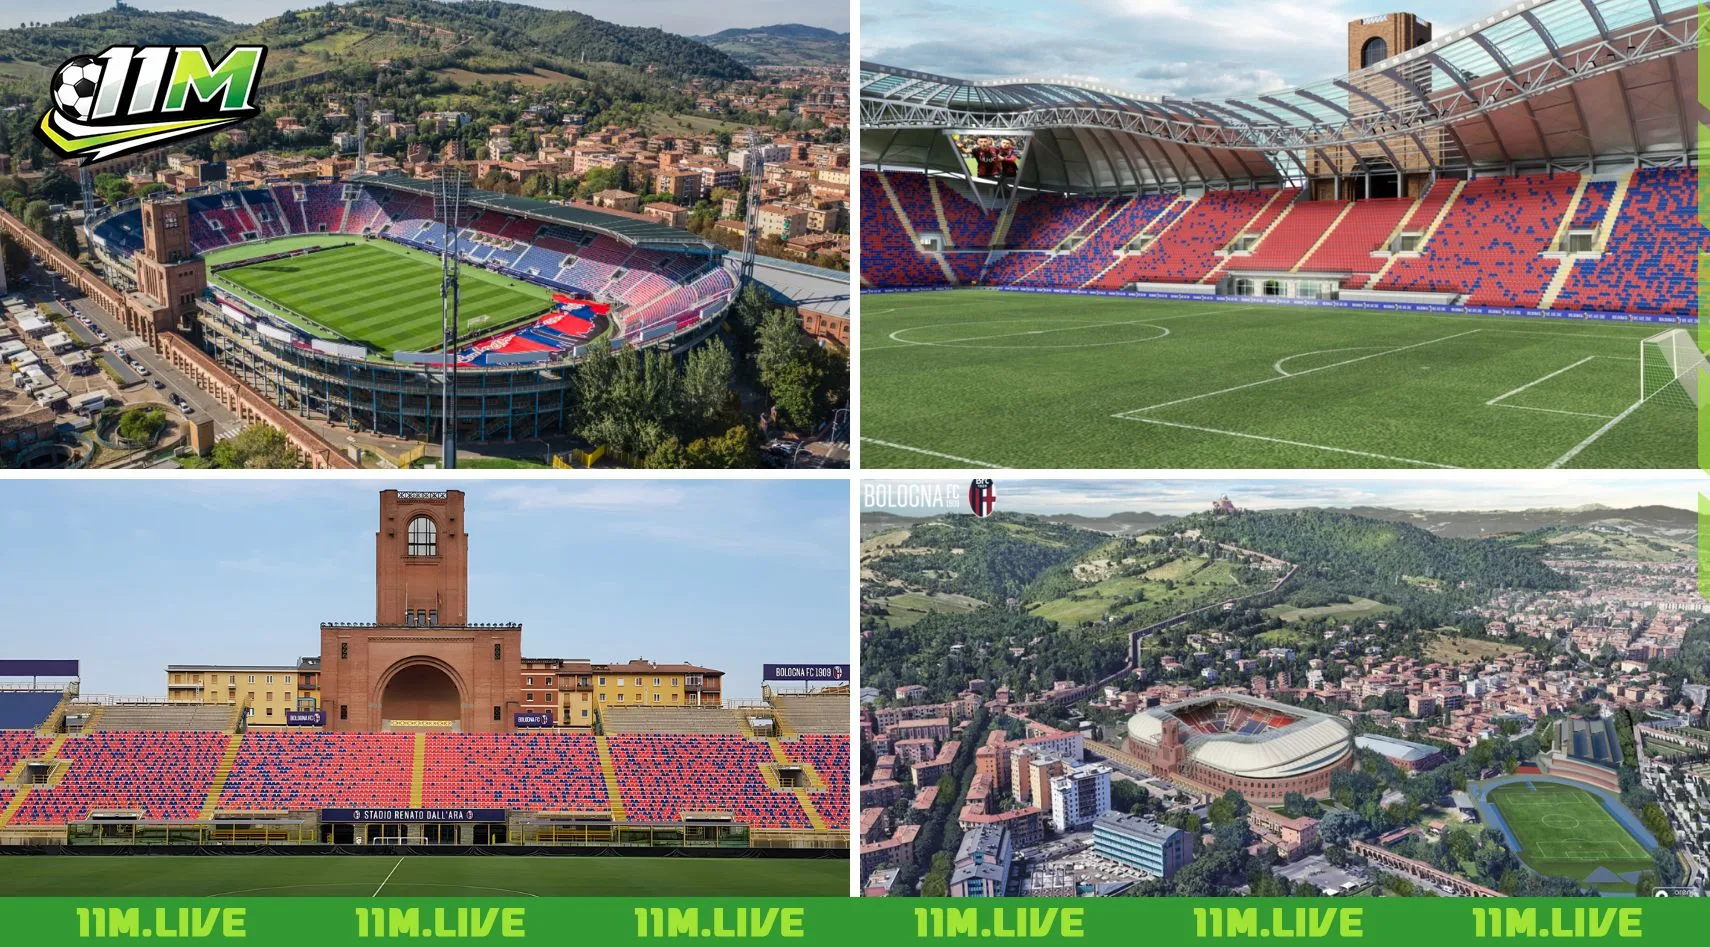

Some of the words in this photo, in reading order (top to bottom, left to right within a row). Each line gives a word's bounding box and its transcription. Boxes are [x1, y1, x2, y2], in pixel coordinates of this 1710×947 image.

[775, 667, 805, 677] BOLOGNA
[806, 667, 815, 677] FC
[815, 667, 832, 677] 1909
[364, 810, 392, 820] STADIO
[394, 810, 424, 820] RENATO
[426, 810, 464, 820] DALL'ARA
